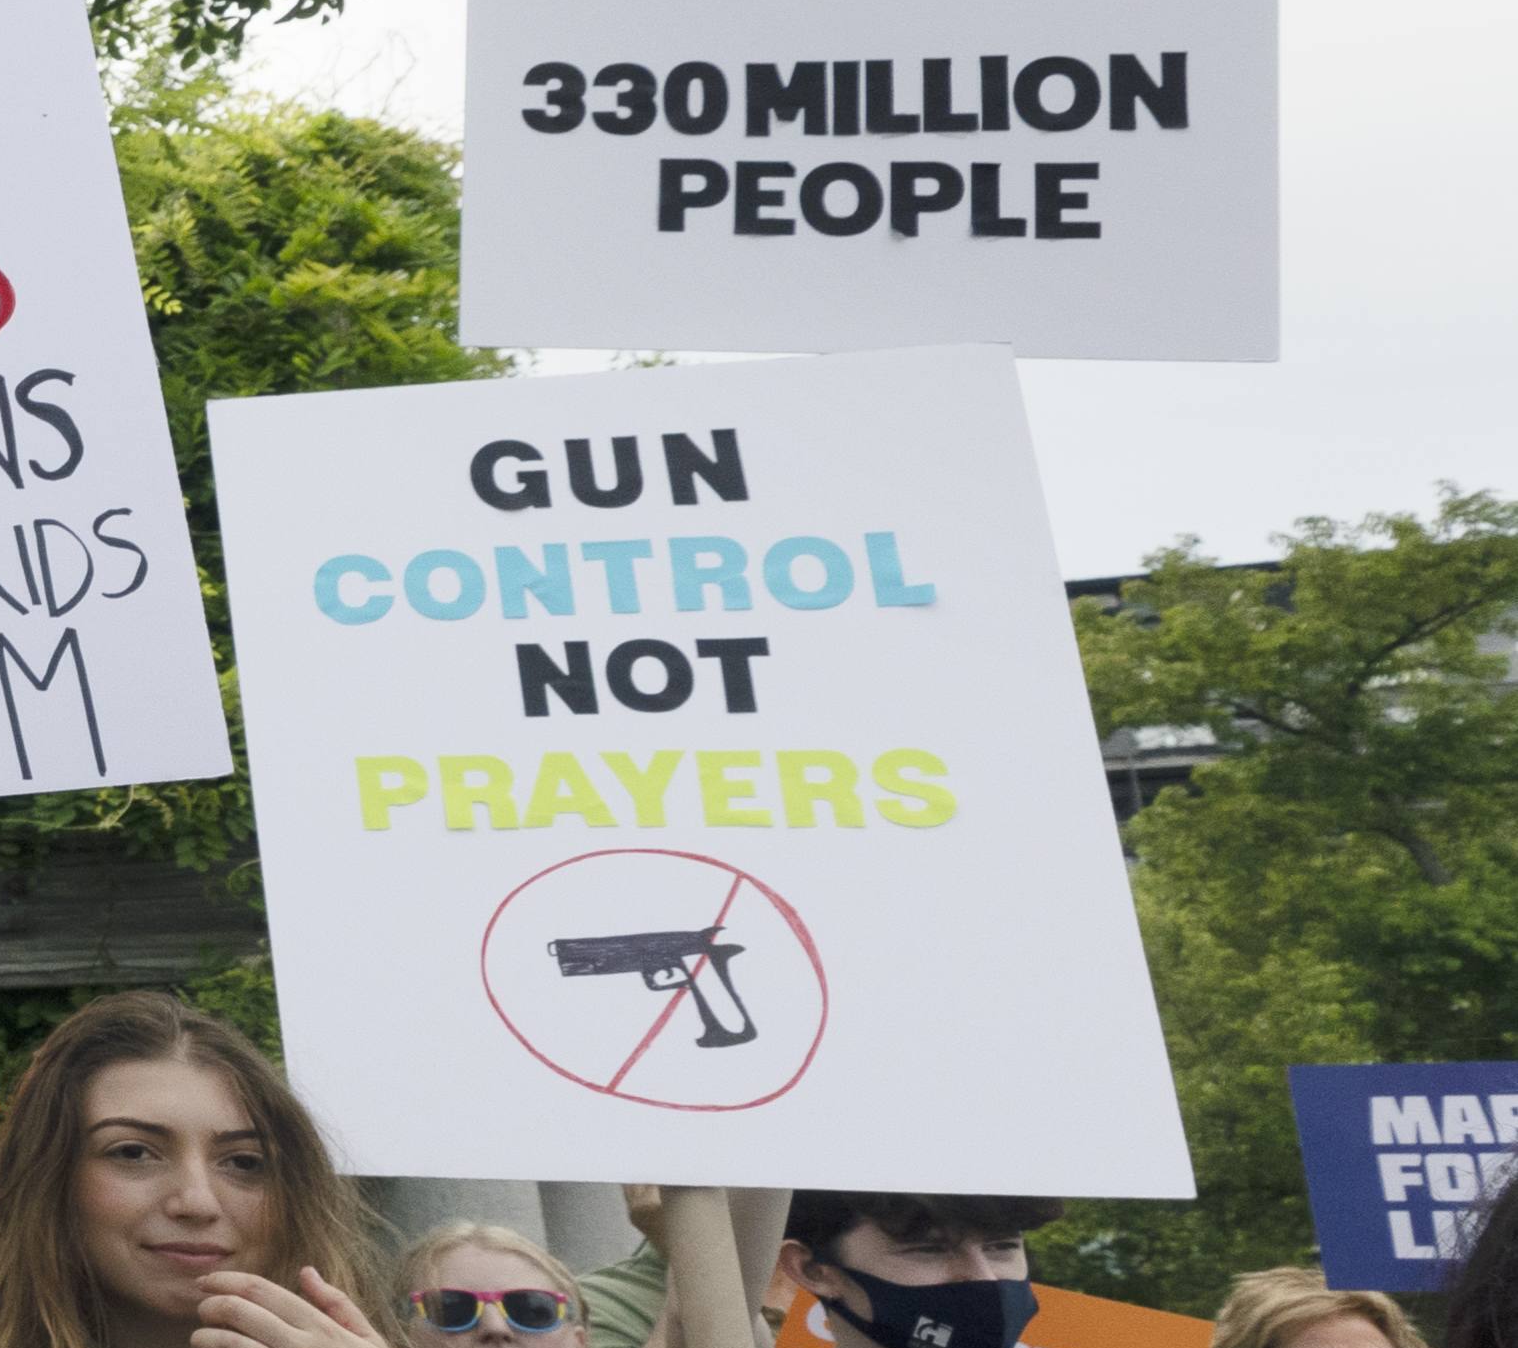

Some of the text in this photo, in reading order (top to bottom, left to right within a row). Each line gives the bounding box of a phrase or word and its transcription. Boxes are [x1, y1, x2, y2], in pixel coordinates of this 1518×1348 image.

[519, 50, 1190, 139] 330 MILLION
[656, 157, 1104, 242] PEOPLE
[468, 427, 751, 512] GUN
[312, 530, 937, 627] CONTROL
[514, 635, 771, 718] NOT
[353, 747, 959, 832] PRAYERS
